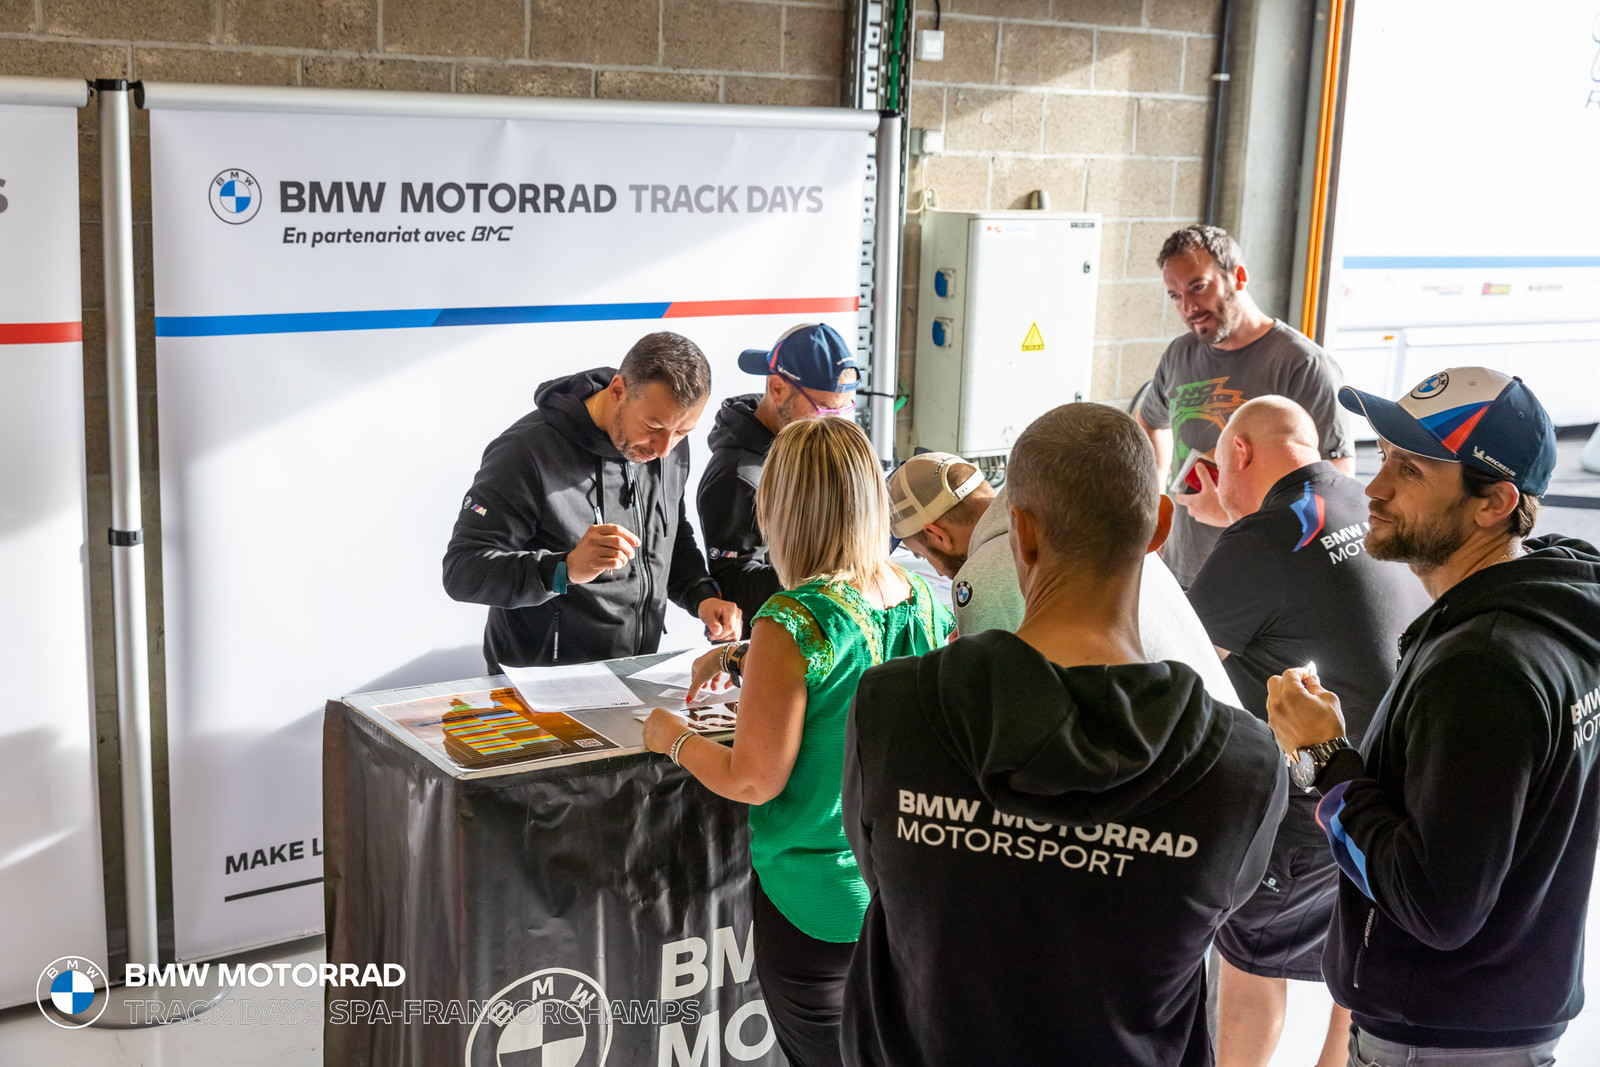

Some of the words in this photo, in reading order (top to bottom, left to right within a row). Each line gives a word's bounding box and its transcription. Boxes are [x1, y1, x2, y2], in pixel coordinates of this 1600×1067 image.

[280, 180, 386, 213] BMW
[400, 182, 617, 214] MOTORRAD
[629, 184, 739, 213] TRACK
[747, 185, 824, 214] DAYS
[283, 227, 306, 244] En
[311, 225, 421, 248] partenariat
[424, 231, 466, 243] avec
[1484, 455, 1517, 477] MICHELIN
[1320, 523, 1363, 550] BMW
[899, 789, 982, 823] BMW
[225, 840, 304, 875] MAKE
[897, 816, 1135, 877] MOTORSPORT
